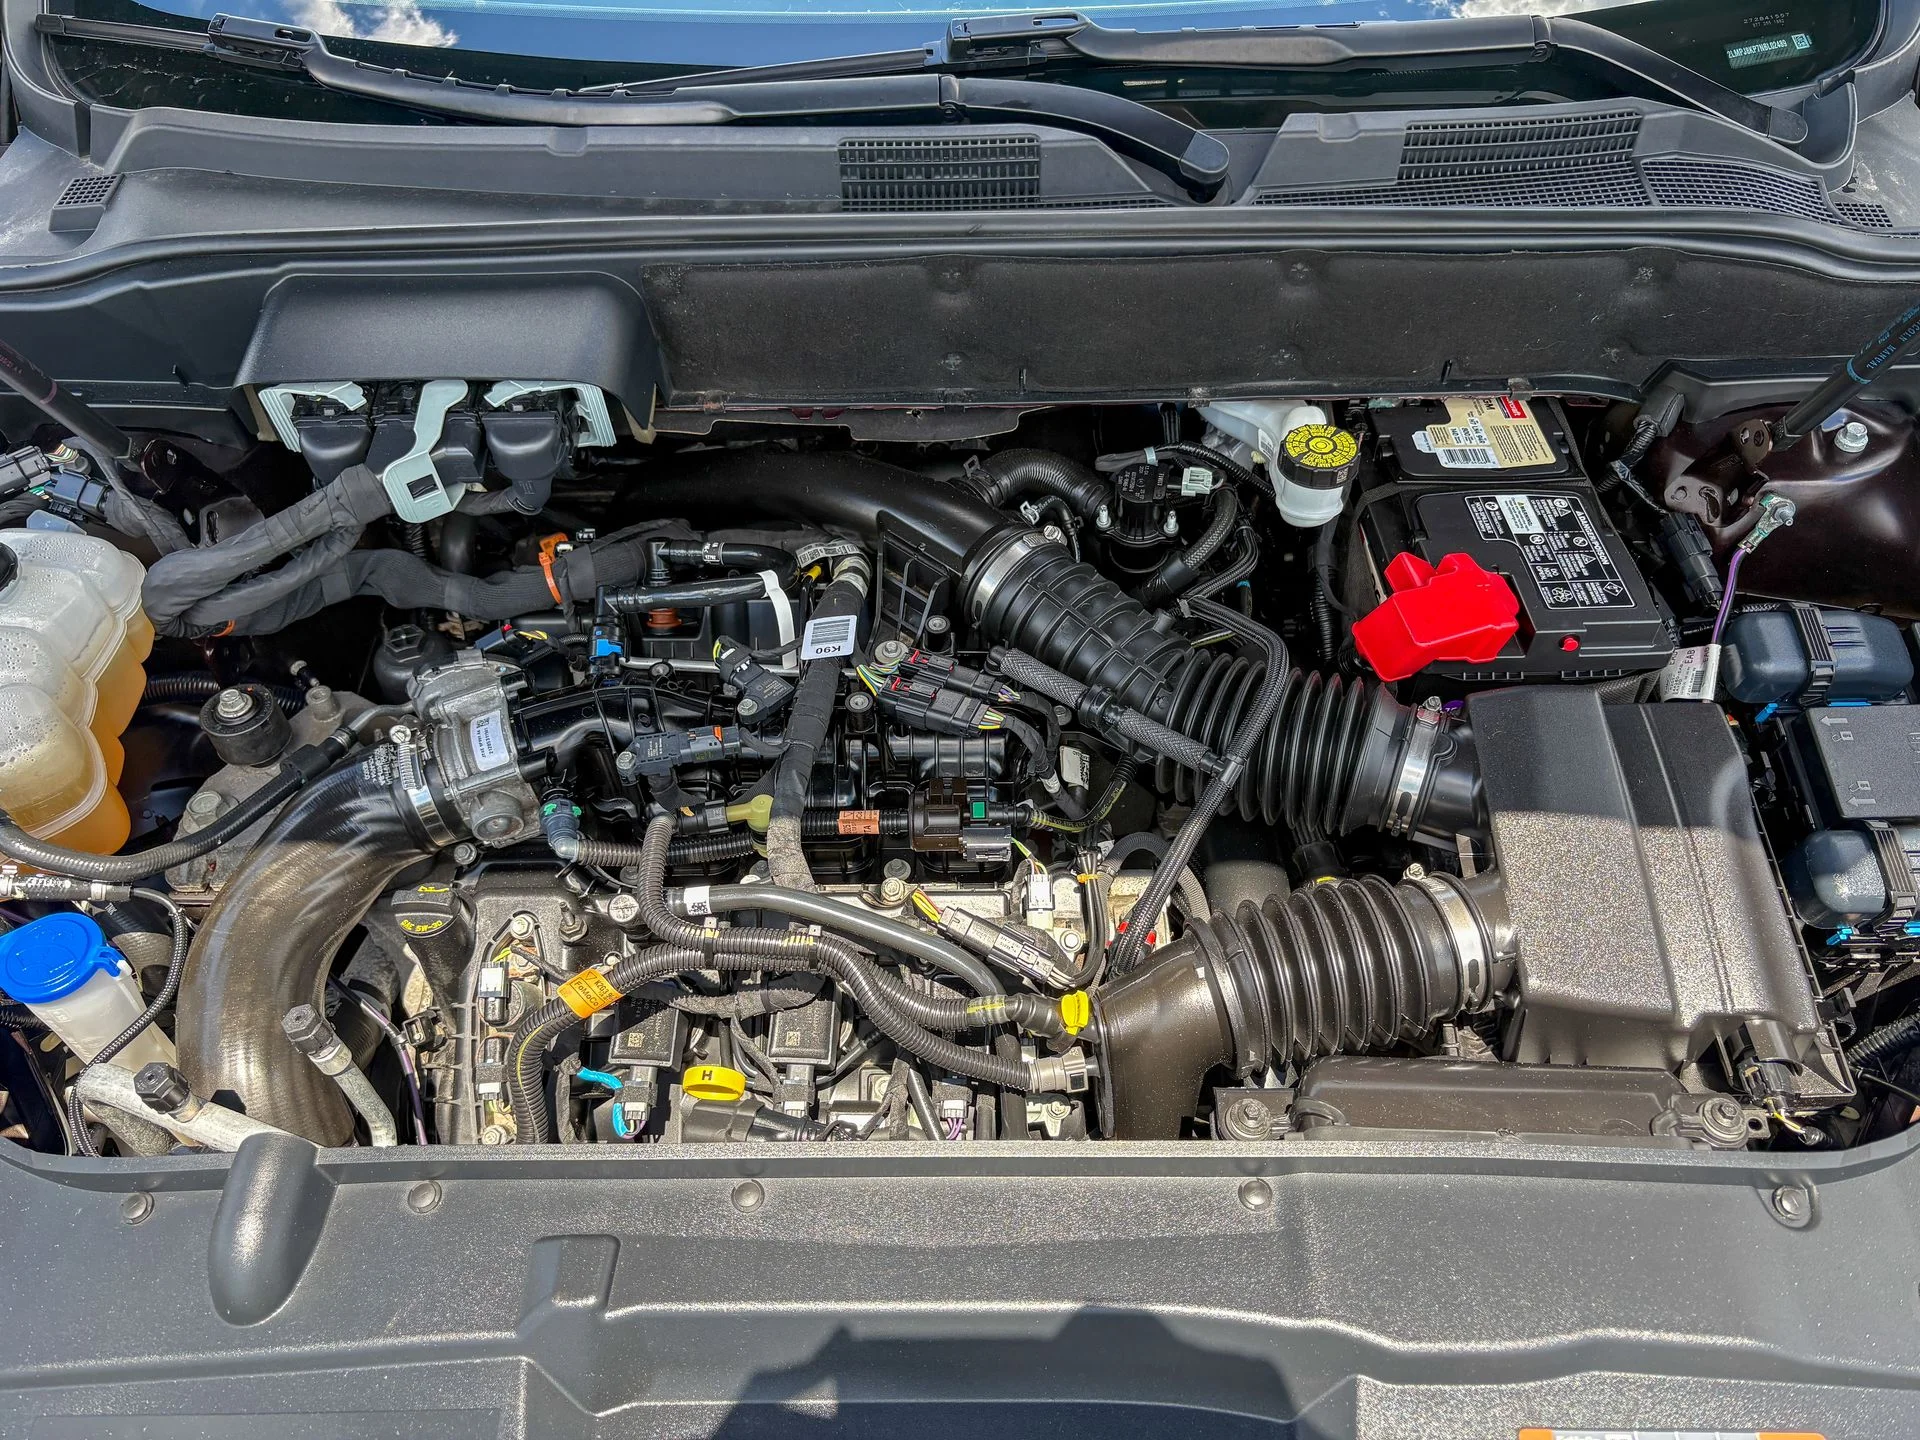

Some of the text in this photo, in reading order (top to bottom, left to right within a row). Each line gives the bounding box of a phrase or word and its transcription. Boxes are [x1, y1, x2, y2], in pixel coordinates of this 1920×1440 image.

[1866, 344, 1897, 369] MANUAL
[815, 644, 841, 654] K90
[1685, 649, 1695, 664] EAB
[400, 919, 415, 931] SAE
[574, 980, 599, 1007] FoMoCo
[701, 1069, 713, 1081] H
